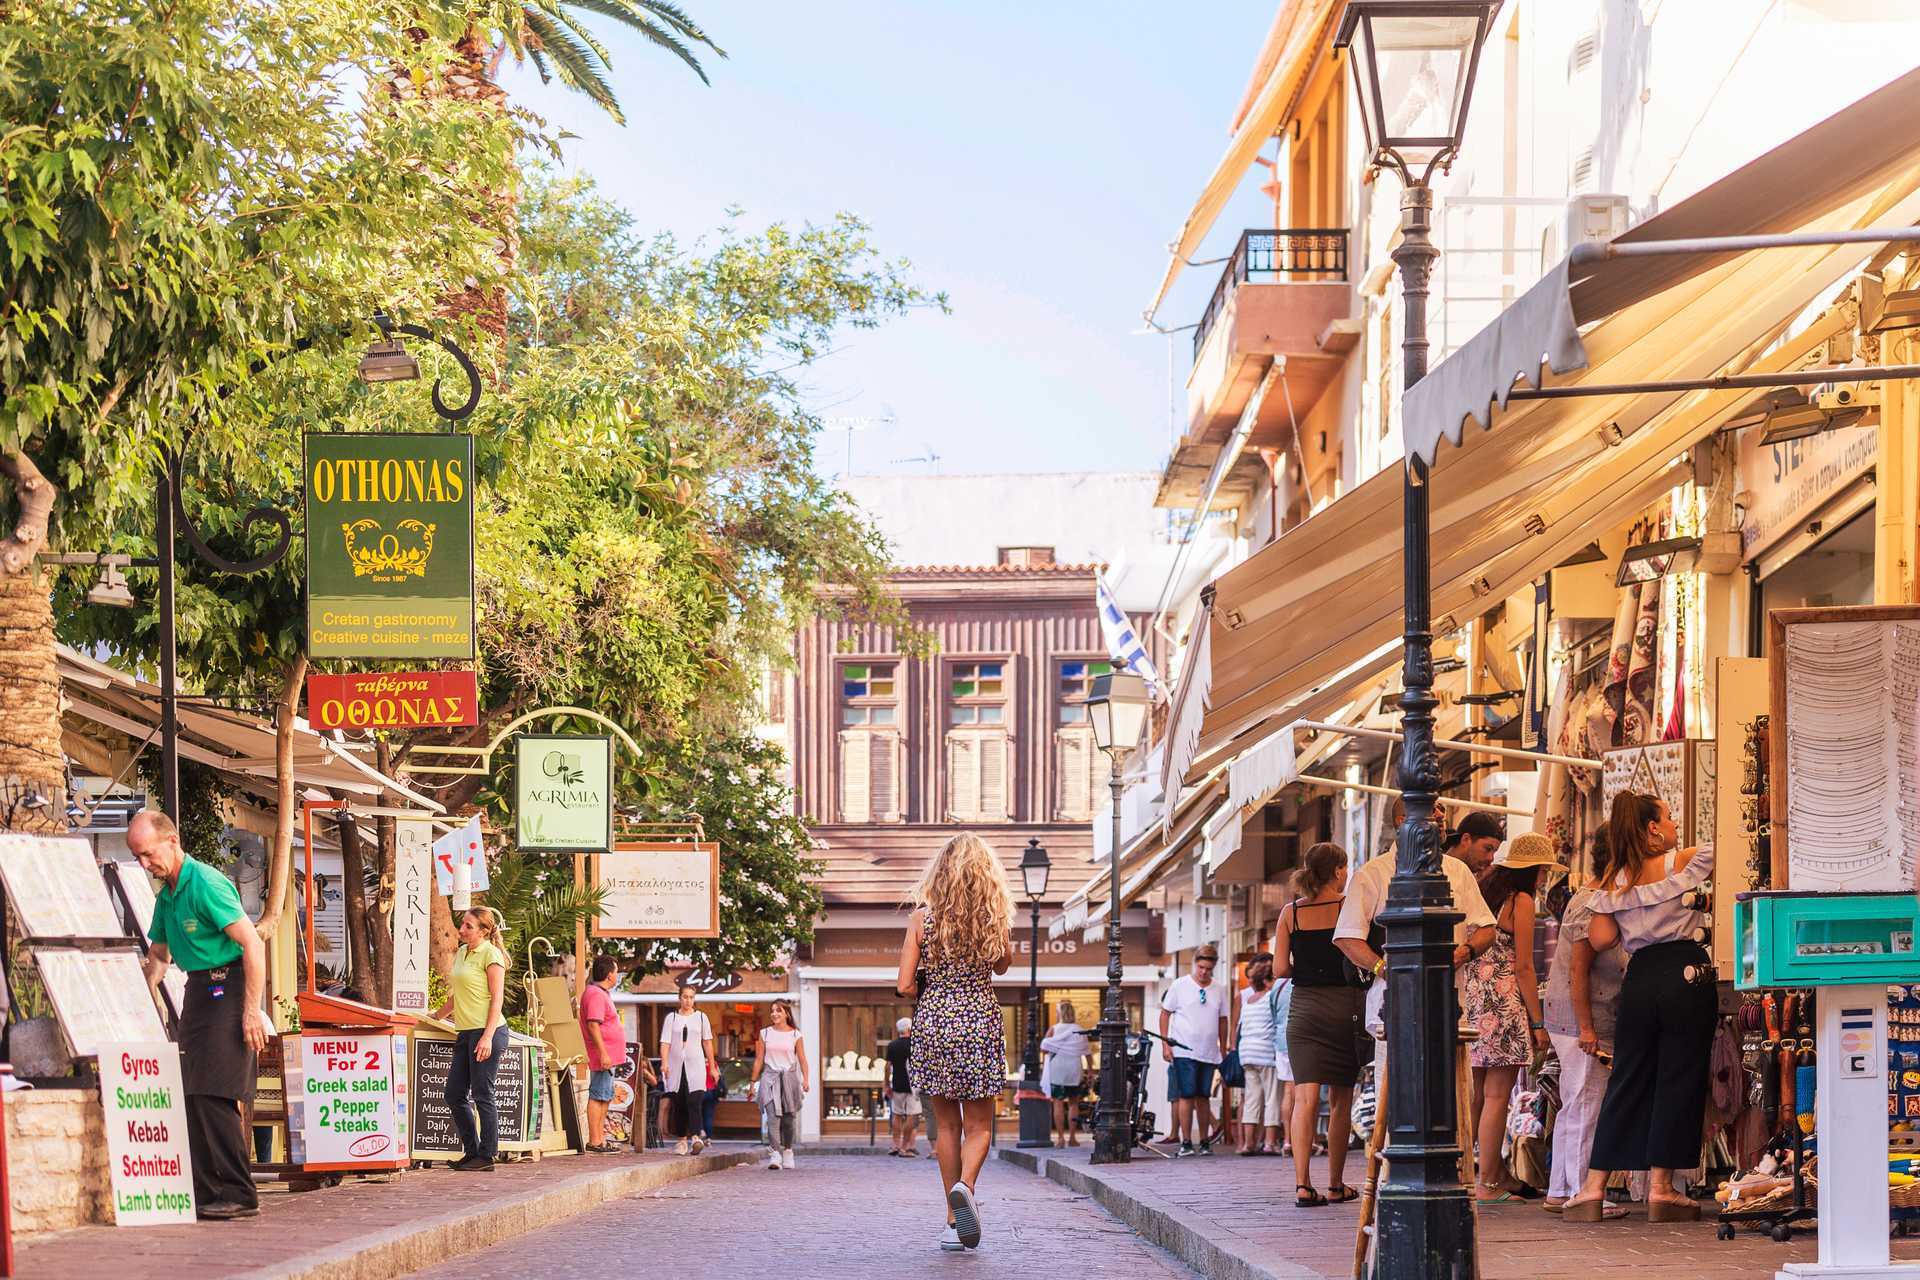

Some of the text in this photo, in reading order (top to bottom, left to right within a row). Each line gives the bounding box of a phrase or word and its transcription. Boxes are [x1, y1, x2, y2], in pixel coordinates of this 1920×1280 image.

[313, 459, 464, 503] OTHONAS
[372, 575, 390, 583] Since
[323, 612, 457, 629] Cretan gastronomy
[312, 630, 368, 644] Creative
[372, 631, 419, 644] cuisine
[432, 633, 468, 644] meze
[355, 676, 429, 698] ταβέρνα
[321, 696, 465, 727] ΟΘΩΝΑΣ
[528, 789, 599, 809] AGRIMIA
[606, 877, 705, 891] Μπακαλόγατος
[404, 864, 426, 971] AGRIMIA
[1008, 940, 1077, 953] TEIOS
[397, 992, 423, 1000] LOCAL
[313, 1041, 358, 1055] MENU
[121, 1052, 159, 1081] Gyros
[327, 1051, 380, 1071] For 2
[306, 1076, 388, 1093] Greek salad
[116, 1087, 172, 1109] Souvlaki
[319, 1099, 380, 1127] 2 Pepper
[422, 1103, 452, 1114] Musse
[128, 1120, 168, 1142] Kebab
[334, 1117, 378, 1132] steaks
[427, 1120, 449, 1133] Daily
[416, 1133, 459, 1145] Fresh Fish
[122, 1154, 181, 1177] Schnitzel
[117, 1188, 191, 1215] Lamb chops
